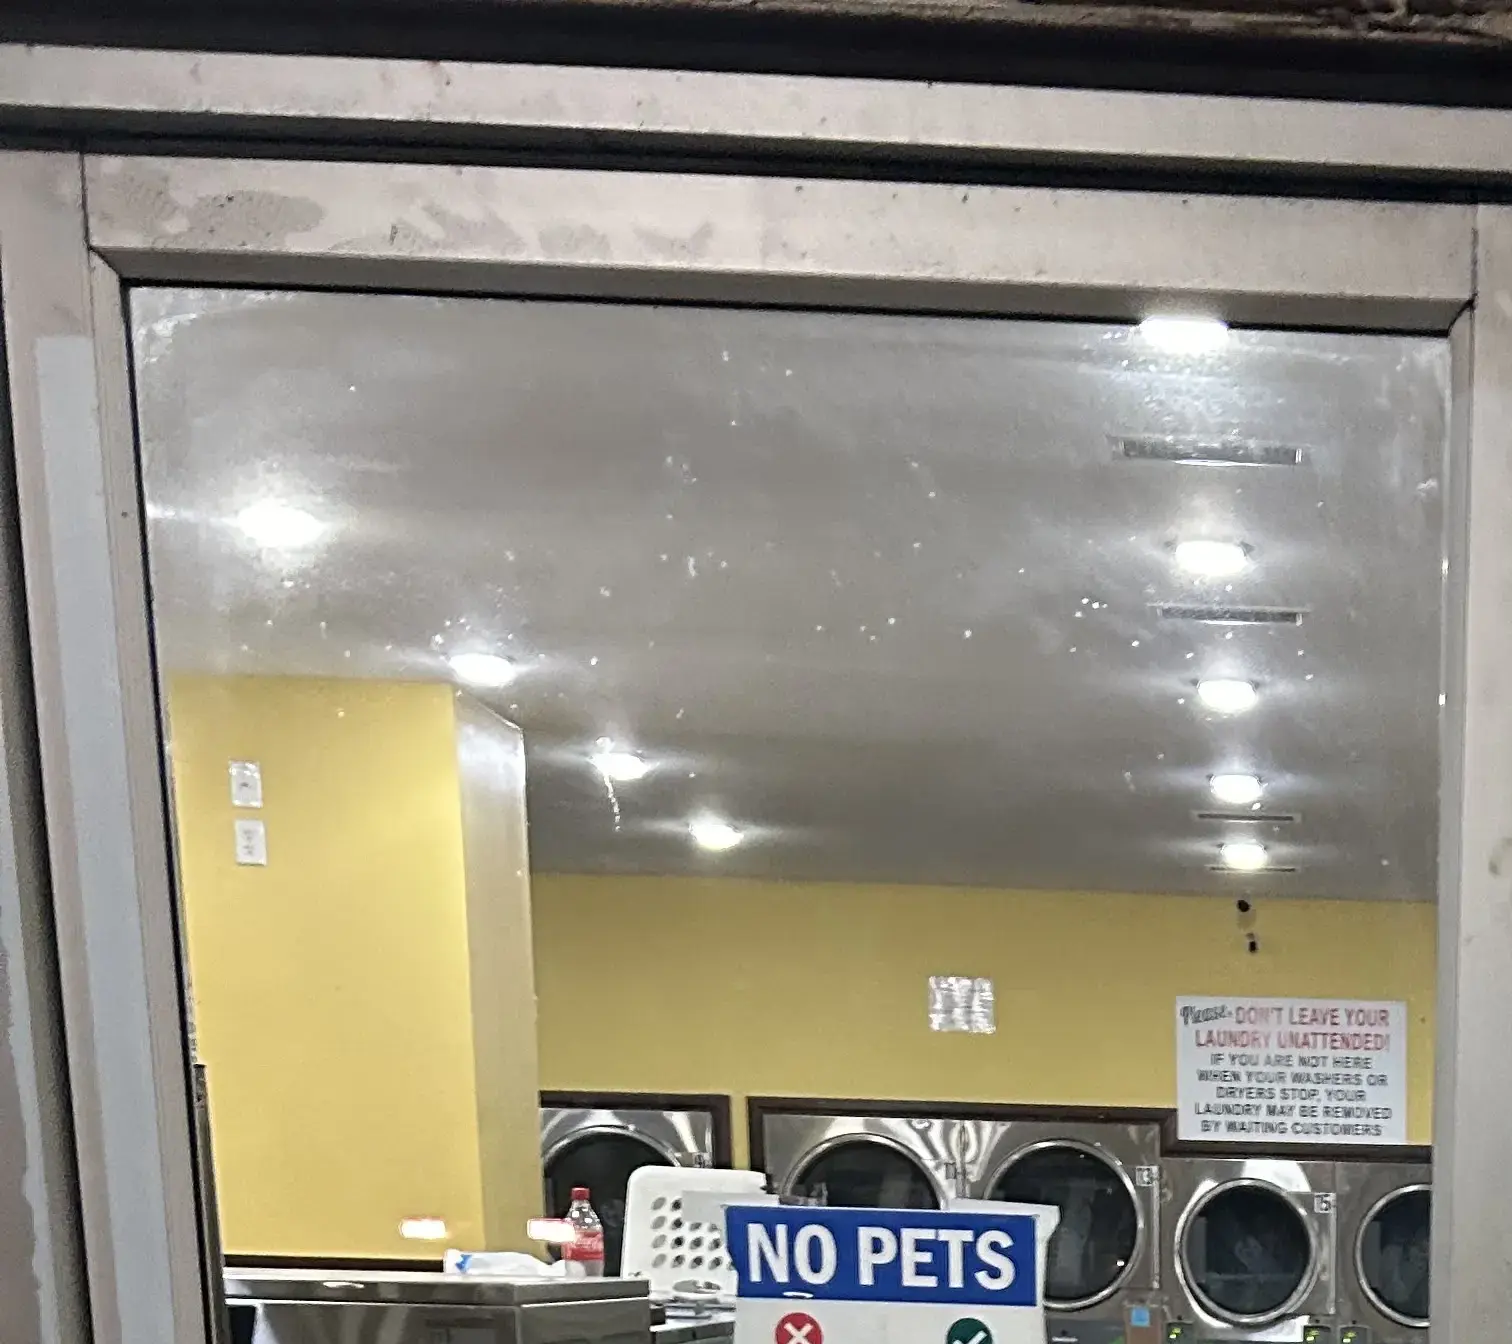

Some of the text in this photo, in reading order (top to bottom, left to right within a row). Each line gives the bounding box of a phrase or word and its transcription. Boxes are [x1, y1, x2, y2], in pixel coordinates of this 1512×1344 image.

[1234, 1006, 1284, 1024] DON'T
[1288, 1008, 1341, 1025] LEAVE
[1344, 1008, 1390, 1026] YOUR
[1194, 1030, 1390, 1051] LAUNDRY UNATTENDED!
[1210, 1053, 1373, 1069] IF YOU ARE NOT HERE
[1197, 1069, 1389, 1086] WHEN YOUR WASHERS OR
[1215, 1086, 1276, 1100] DRYERS
[1324, 1089, 1366, 1101] YOUR
[1194, 1102, 1393, 1120] LAUNDRY MAY BE REMOVED
[1200, 1119, 1383, 1136] BY WAITING CUSTOMERS
[747, 1223, 1017, 1290] NO PETS
